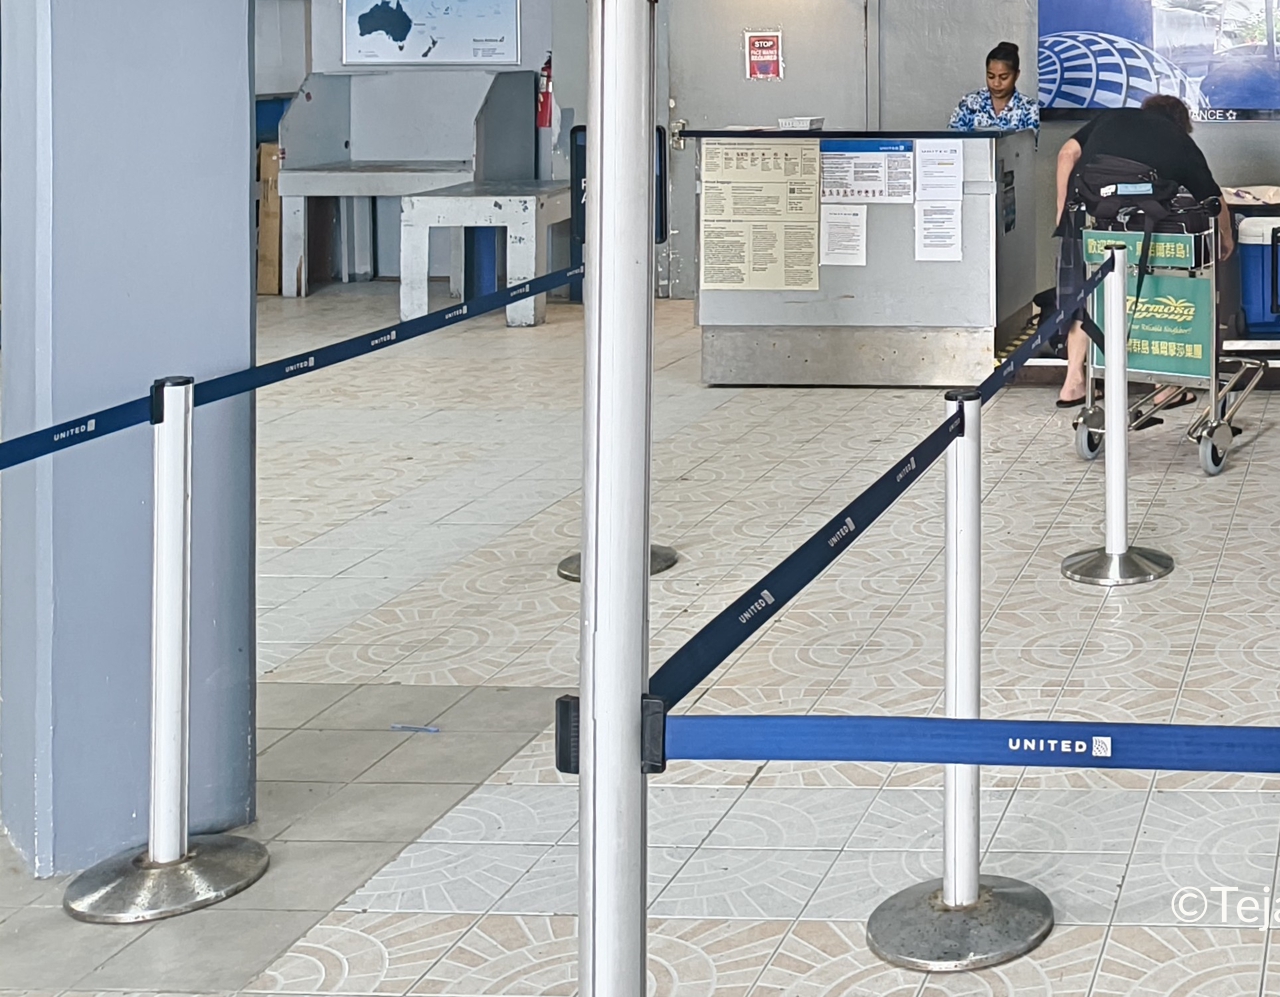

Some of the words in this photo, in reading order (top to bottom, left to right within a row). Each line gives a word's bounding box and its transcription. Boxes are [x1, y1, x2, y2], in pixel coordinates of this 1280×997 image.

[370, 334, 391, 347] UNITED
[285, 360, 309, 374] UNITED
[53, 425, 87, 442] UNITED
[828, 525, 850, 547] UNITED
[738, 598, 766, 624] UNITED
[1008, 737, 1088, 754] UNITED
